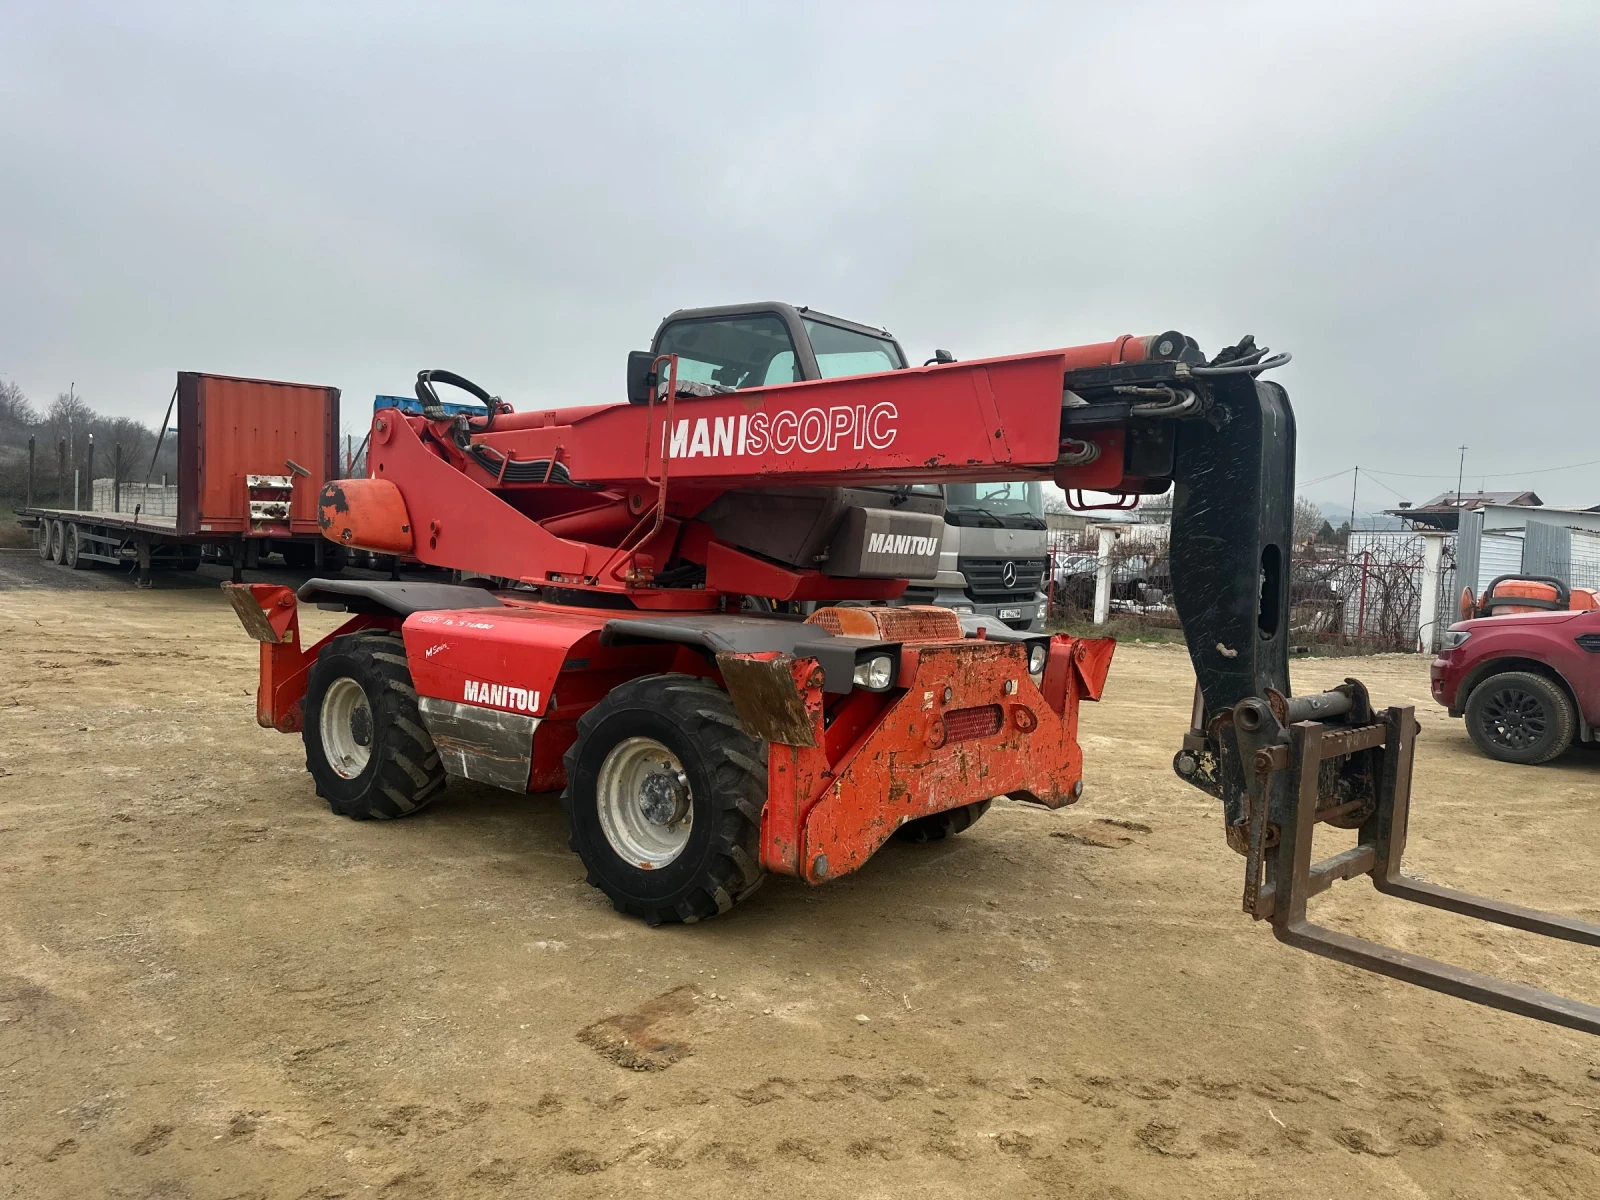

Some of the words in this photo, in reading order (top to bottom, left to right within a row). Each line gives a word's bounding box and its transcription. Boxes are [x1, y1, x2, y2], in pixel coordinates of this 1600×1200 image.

[661, 402, 898, 459] MANISCOPIC
[868, 533, 938, 556] MANITOU
[464, 680, 540, 712] MANITOU
